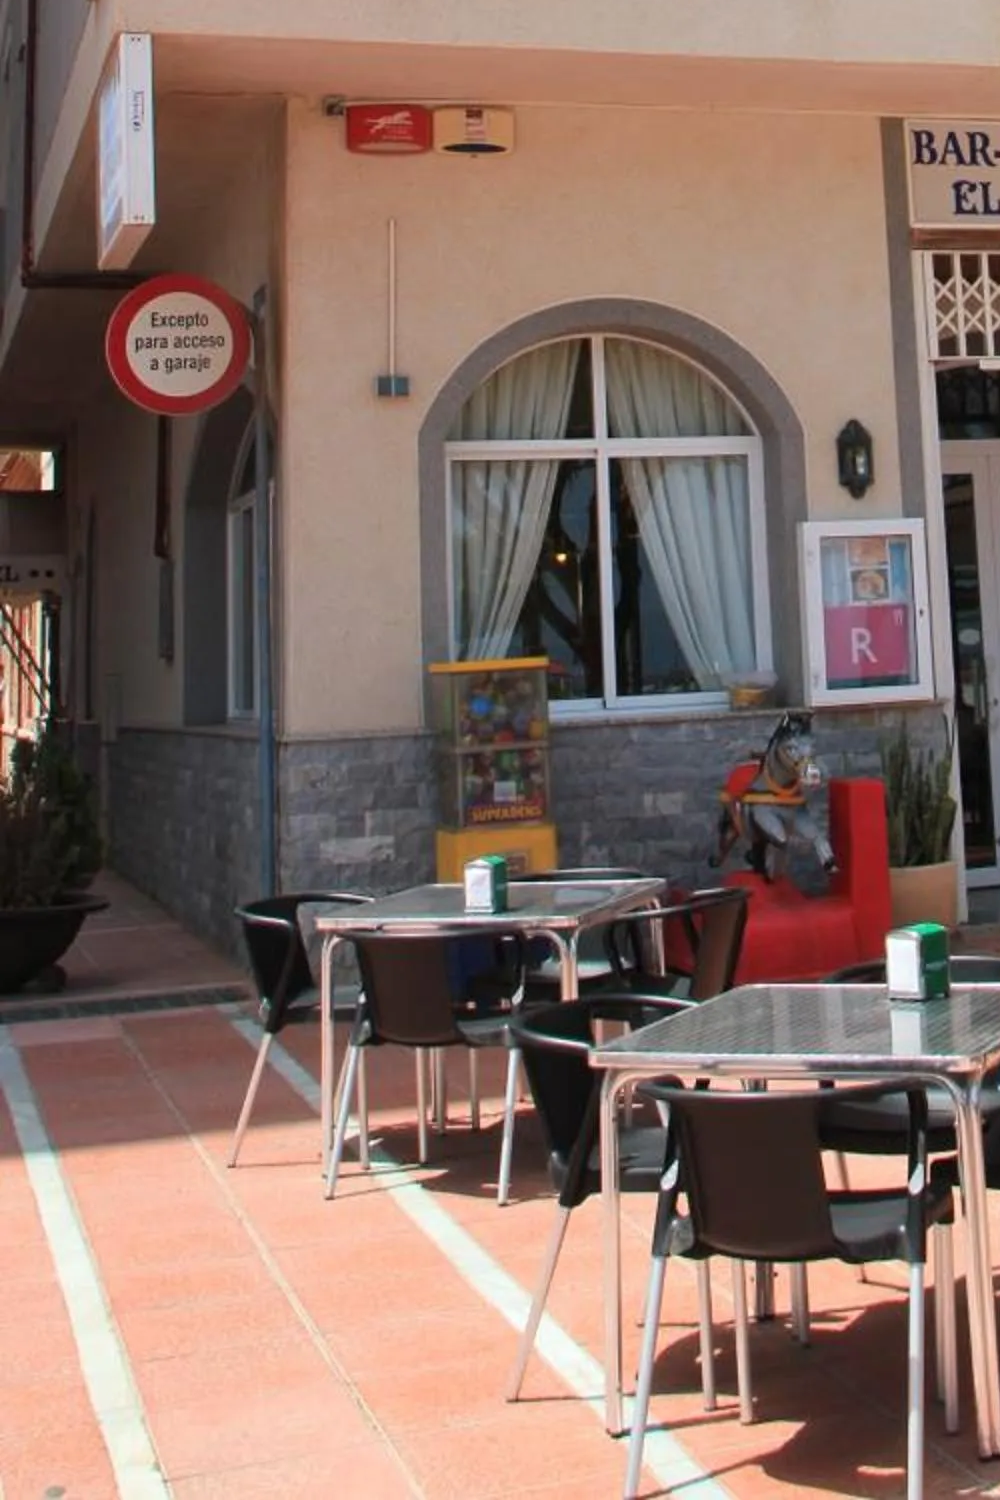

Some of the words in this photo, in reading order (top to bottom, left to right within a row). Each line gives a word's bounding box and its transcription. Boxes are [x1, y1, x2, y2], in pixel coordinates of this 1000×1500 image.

[151, 312, 208, 329] Excepto
[135, 335, 169, 354] para
[173, 334, 226, 349] acceso
[149, 357, 160, 371] a
[164, 354, 211, 374] garaje
[0, 565, 20, 583] L
[851, 626, 879, 664] R
